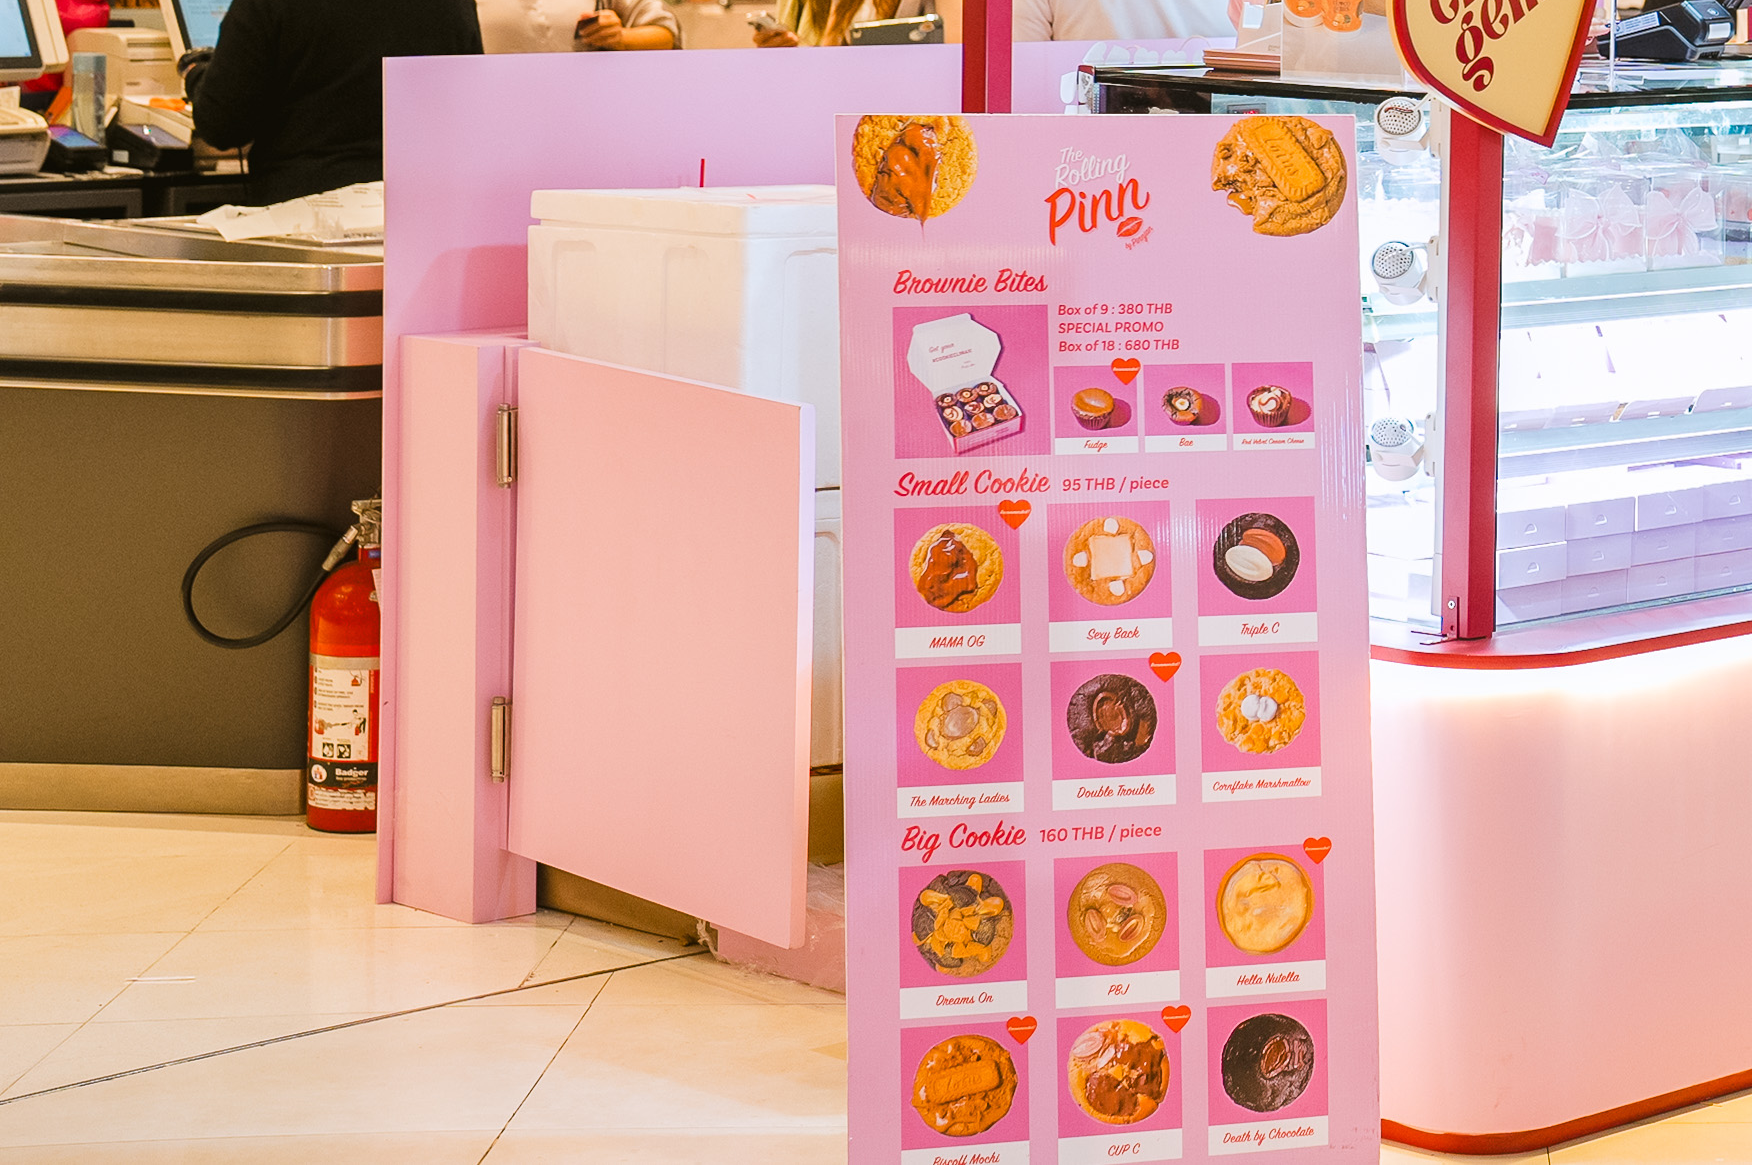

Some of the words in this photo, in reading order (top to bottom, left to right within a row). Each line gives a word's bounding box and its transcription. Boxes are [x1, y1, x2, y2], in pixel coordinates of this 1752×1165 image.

[1060, 146, 1085, 164] The
[1054, 153, 1131, 190] Rolling
[1044, 178, 1151, 246] Pinn
[892, 269, 989, 296] Brownie
[993, 268, 1048, 294] Bites
[1058, 304, 1081, 316] Box
[1084, 303, 1099, 315] of
[1100, 303, 1109, 315] 9
[1118, 303, 1144, 315] 380
[1146, 302, 1173, 314] THB
[1058, 322, 1112, 334] SPECIAL
[1114, 321, 1164, 332] PROMO
[1059, 341, 1082, 352] Box
[1085, 339, 1099, 351] of
[1102, 340, 1115, 351] 18
[1125, 340, 1151, 351] 680
[1153, 339, 1180, 350] THB
[1083, 440, 1108, 452] Fudge
[1178, 438, 1194, 447] Bae
[892, 471, 968, 498] Small
[973, 468, 1051, 495] Cookie
[1062, 478, 1082, 492] 95
[1085, 477, 1116, 491] THB
[1129, 477, 1170, 493] piece
[1087, 628, 1111, 646] Sexy
[1113, 627, 1140, 640] Back
[1240, 623, 1269, 636] Triple
[1271, 622, 1281, 634] C
[929, 636, 963, 649] MAMA
[965, 634, 986, 648] OG
[335, 767, 369, 778] Badger
[1076, 785, 1114, 799] Double
[1115, 783, 1156, 797] Trouble
[1212, 780, 1254, 794] Cornflake
[1255, 776, 1312, 790] Marshmallow
[910, 796, 927, 808] The
[930, 794, 976, 810] Marching
[978, 793, 1011, 805] Ladies
[901, 825, 941, 862] Big
[947, 820, 1027, 850] Cookie
[1039, 828, 1068, 843] 160
[1071, 827, 1104, 840] THB
[1119, 823, 1162, 842] piece
[1237, 975, 1263, 987] Hella
[1265, 972, 1300, 986] Nutella
[1107, 984, 1130, 996] PBJ
[936, 994, 974, 1007] Dreams
[976, 992, 994, 1004] On
[1223, 1131, 1251, 1144] Death
[1252, 1131, 1266, 1146] by
[1268, 1126, 1314, 1140] Chocolate
[1107, 1145, 1129, 1157] CUP
[1131, 1143, 1140, 1155] C
[933, 1153, 967, 1165] Biscoff
[969, 1152, 1000, 1165] Mochi
